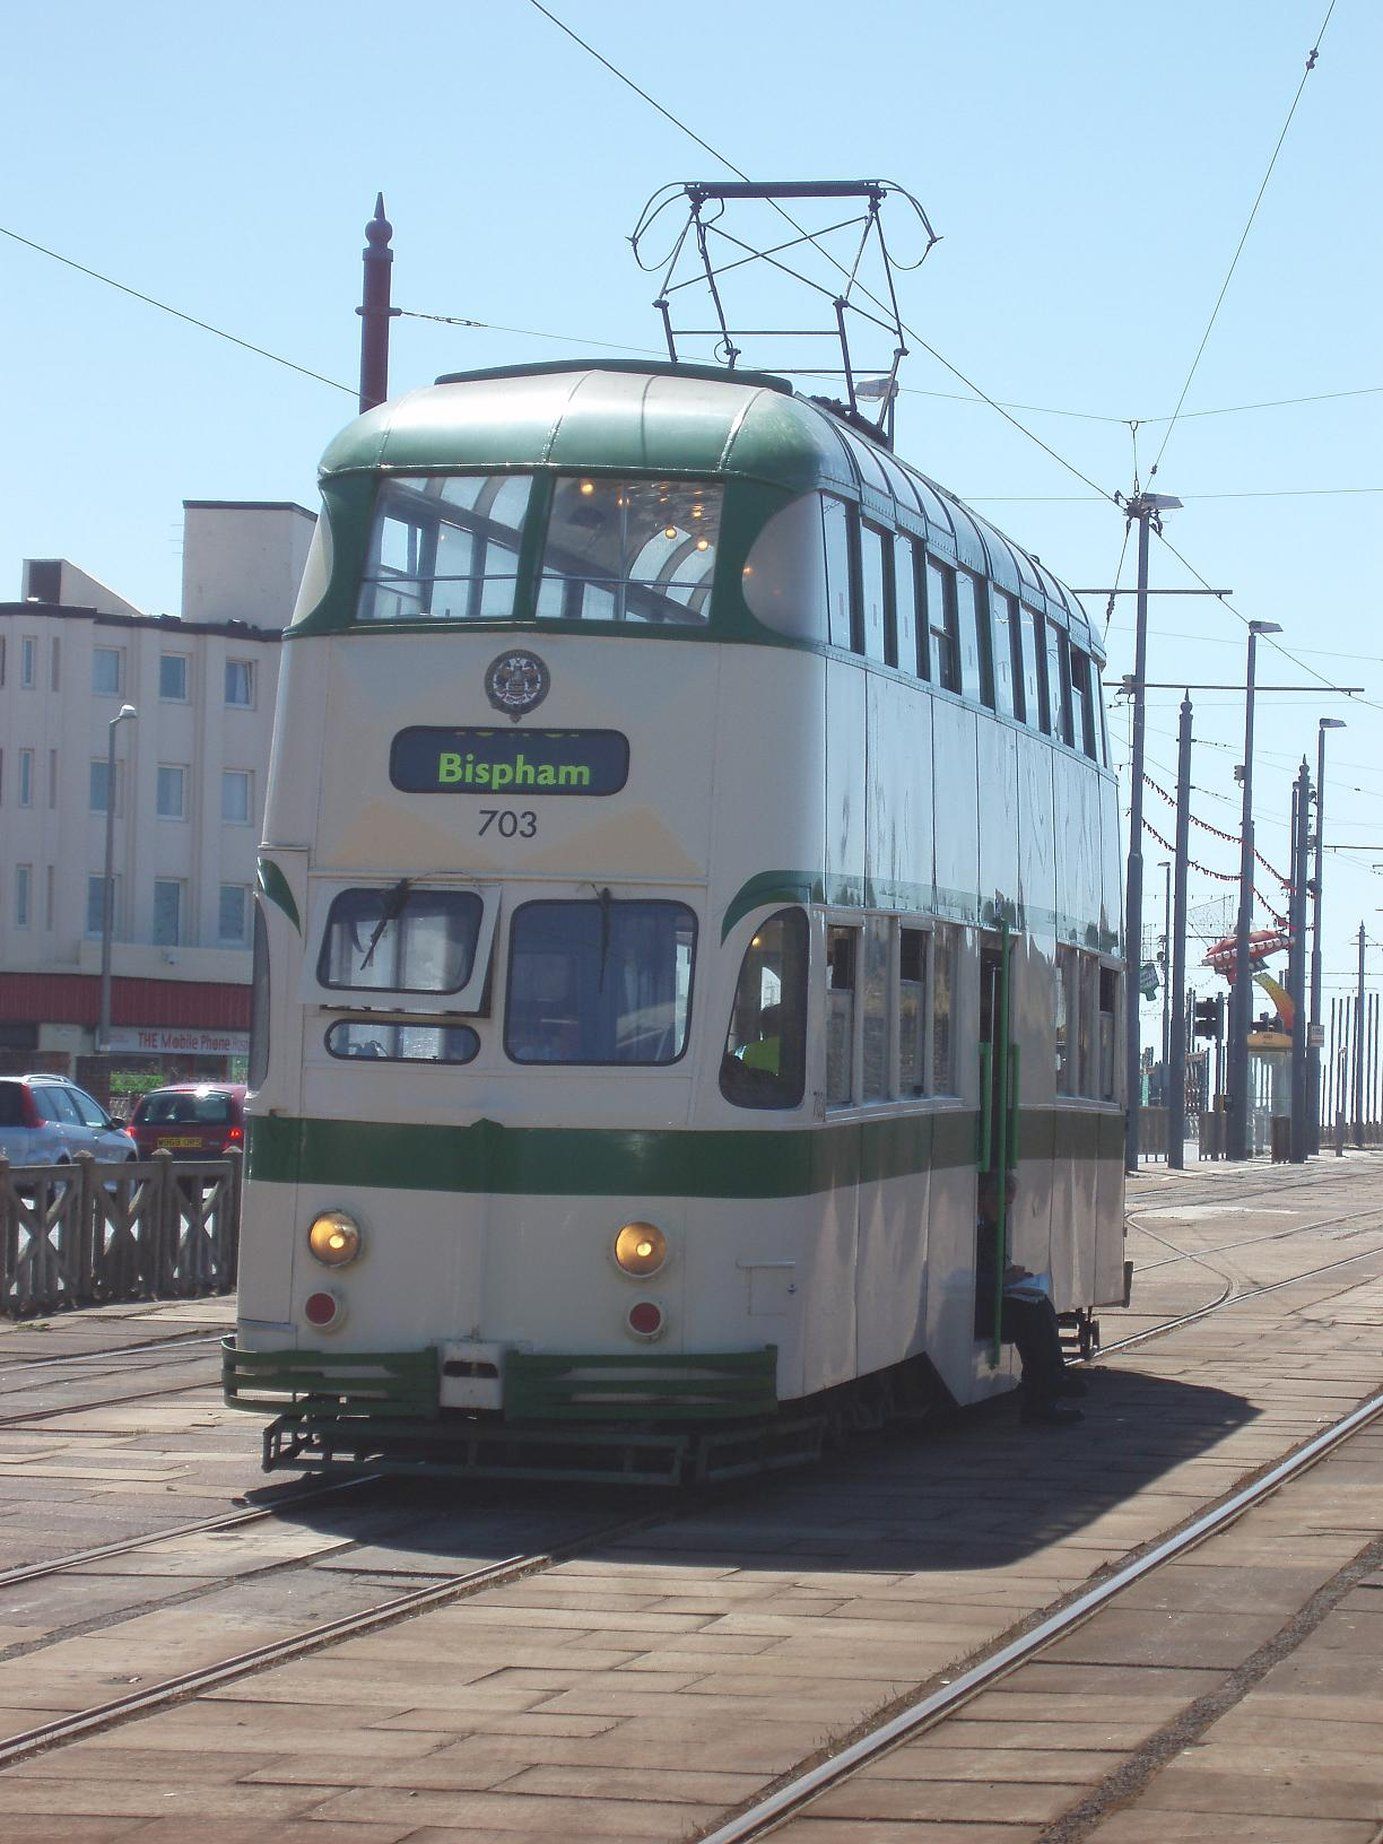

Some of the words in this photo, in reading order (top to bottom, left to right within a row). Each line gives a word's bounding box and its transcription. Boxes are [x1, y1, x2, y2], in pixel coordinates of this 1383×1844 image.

[438, 753, 590, 789] Bispham
[478, 810, 537, 837] 703
[138, 1032, 158, 1049] THE
[161, 1033, 198, 1050] Mobile
[200, 1035, 230, 1051] Phone
